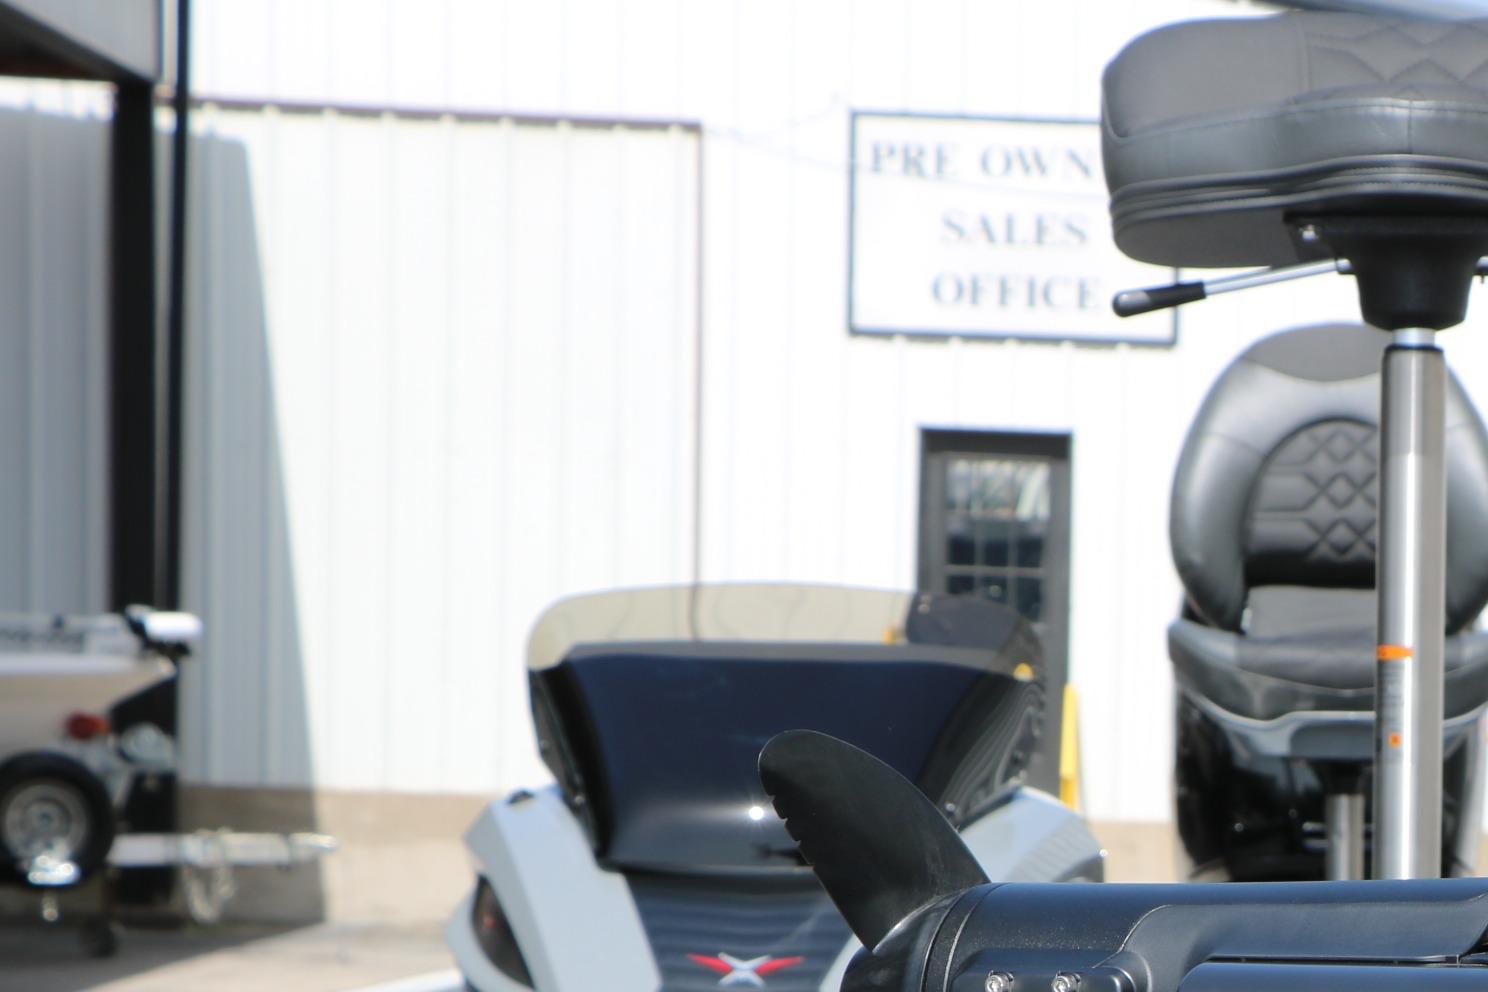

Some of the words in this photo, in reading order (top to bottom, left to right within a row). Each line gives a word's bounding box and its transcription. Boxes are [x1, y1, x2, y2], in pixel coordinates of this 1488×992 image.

[870, 140, 959, 179] PRE
[940, 208, 1090, 247] SALES
[931, 272, 1104, 311] OFFICE
